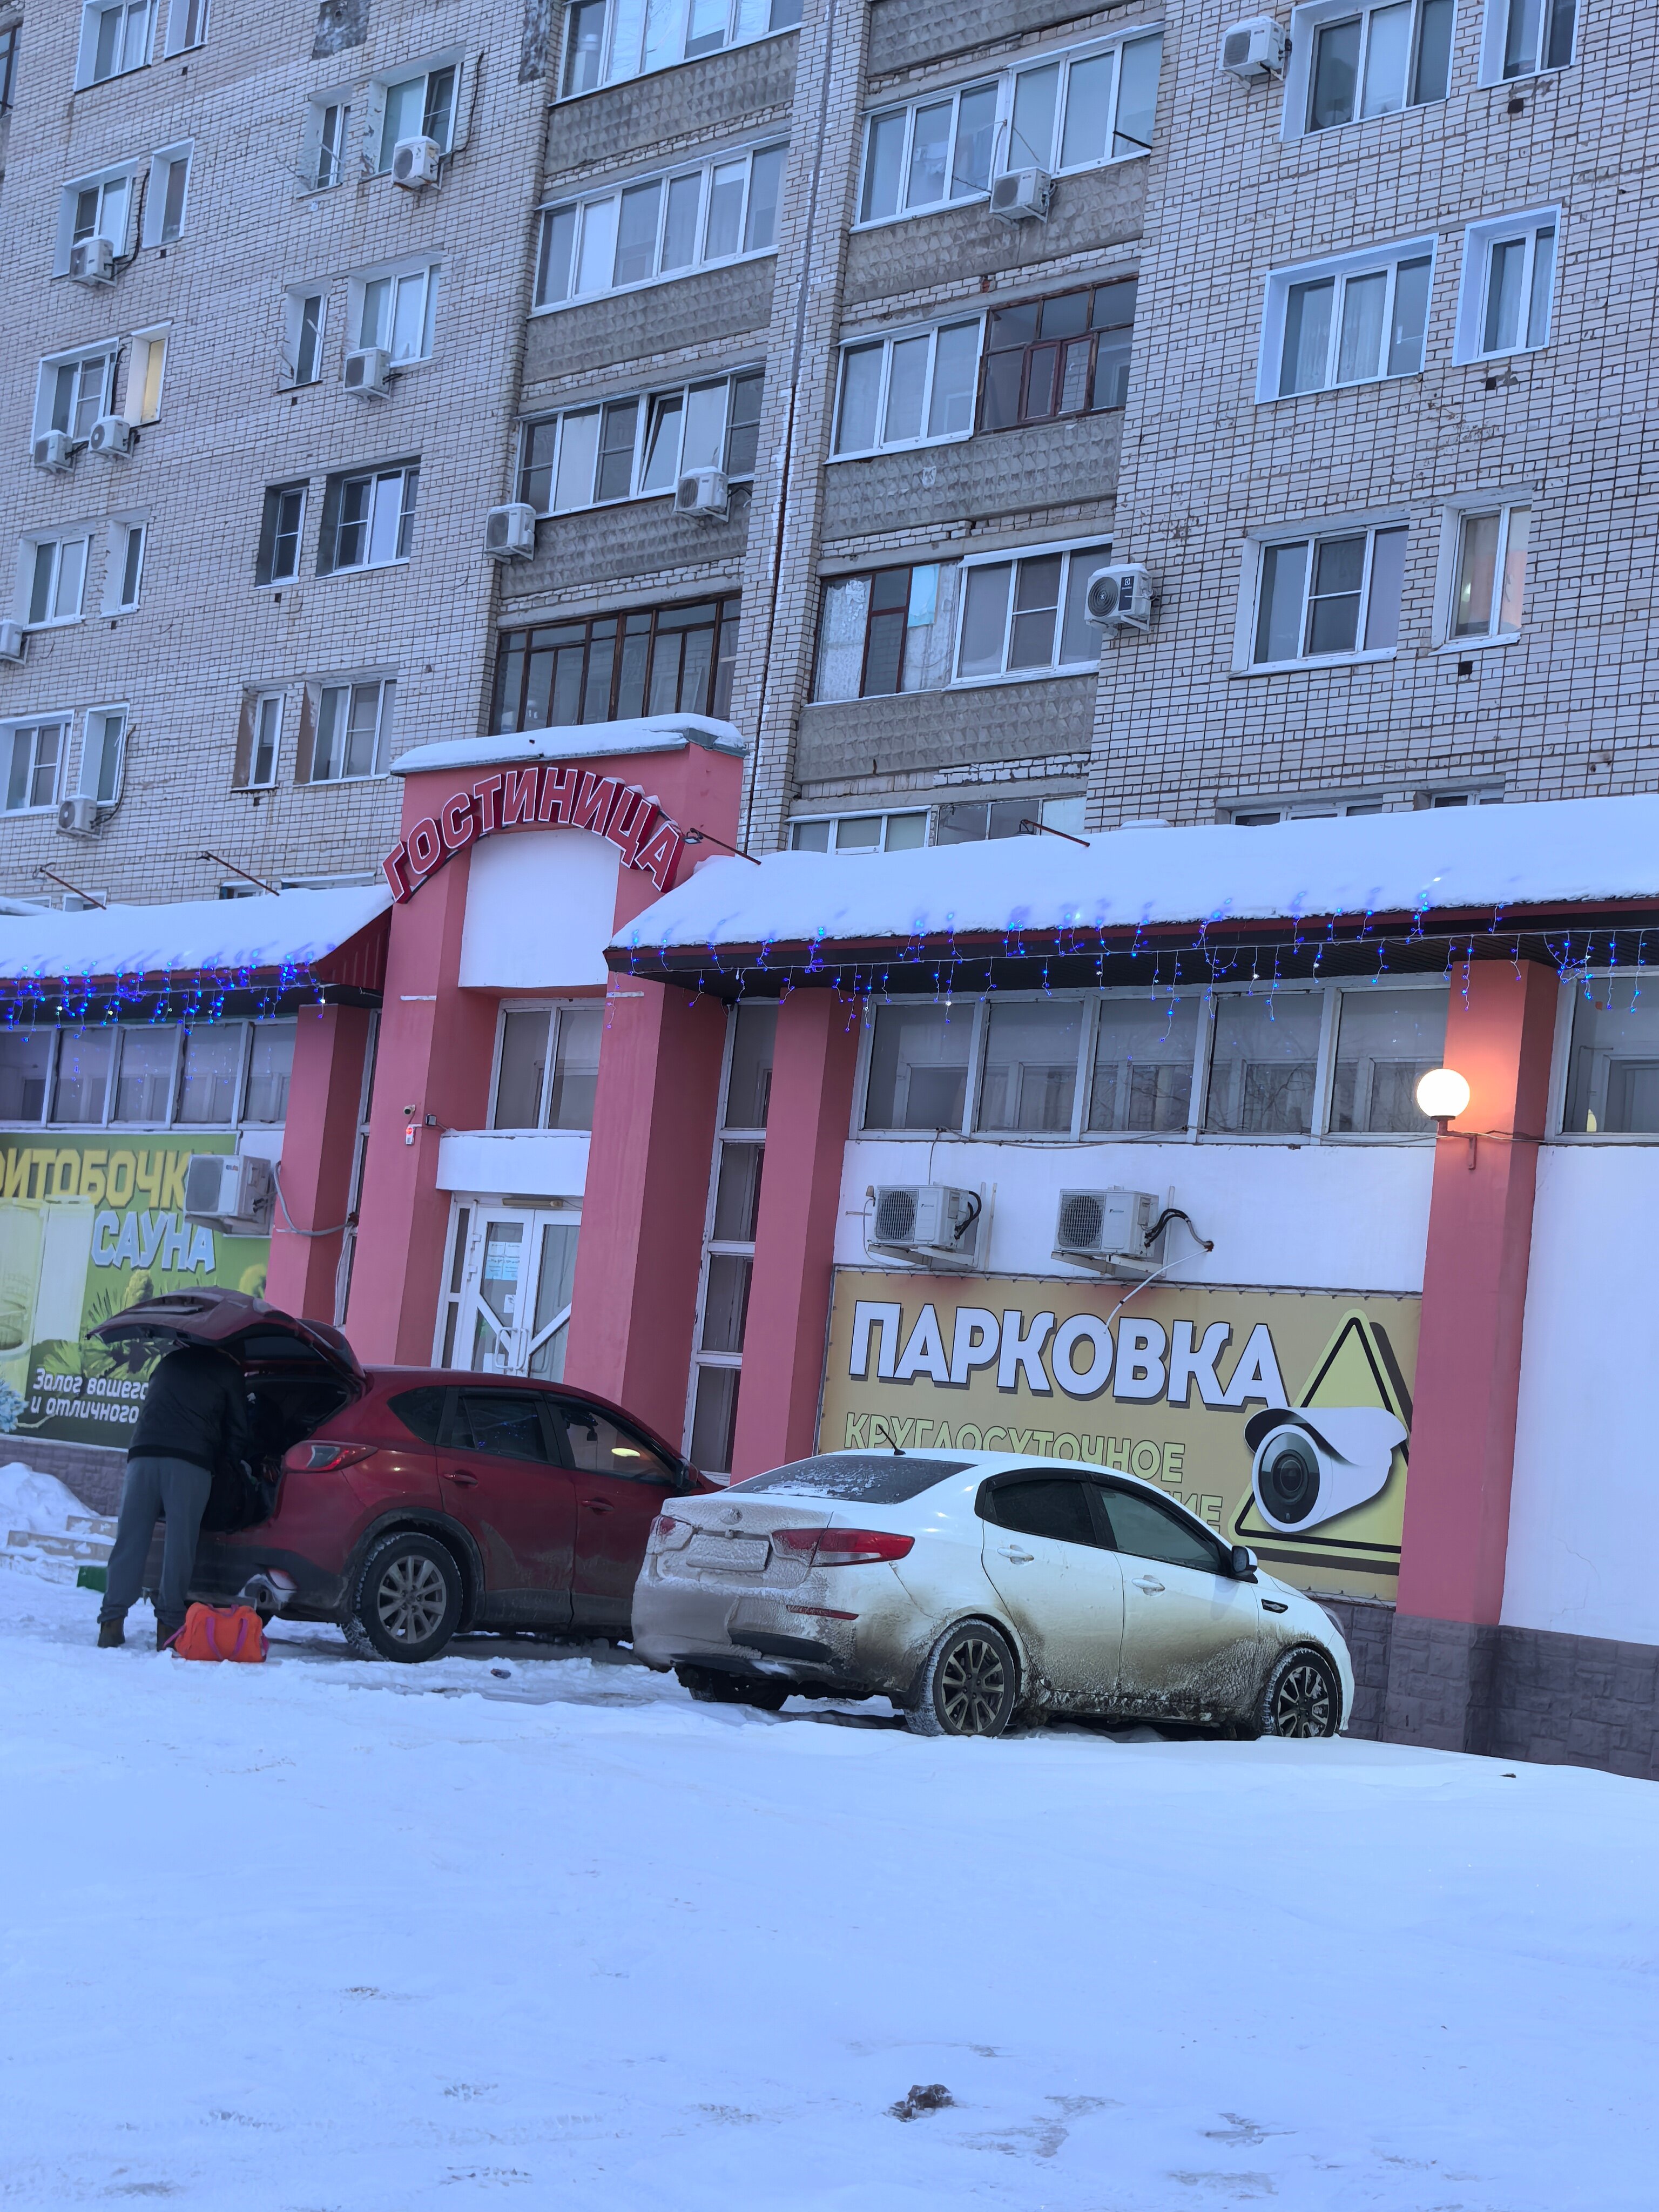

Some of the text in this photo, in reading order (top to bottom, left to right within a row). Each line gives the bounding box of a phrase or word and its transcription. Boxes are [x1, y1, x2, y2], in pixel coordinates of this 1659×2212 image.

[382, 766, 684, 904] ГОСТИНИЦА
[0, 1147, 214, 1211] ИТОБОЧК
[91, 1209, 217, 1274] САУНА
[32, 1367, 83, 1394] Залог
[849, 1300, 1289, 1407] ПАРКОВКА
[30, 1395, 140, 1424] и отличного
[844, 1412, 1185, 1483] КРУГЛОСУТОЧНОЕ
